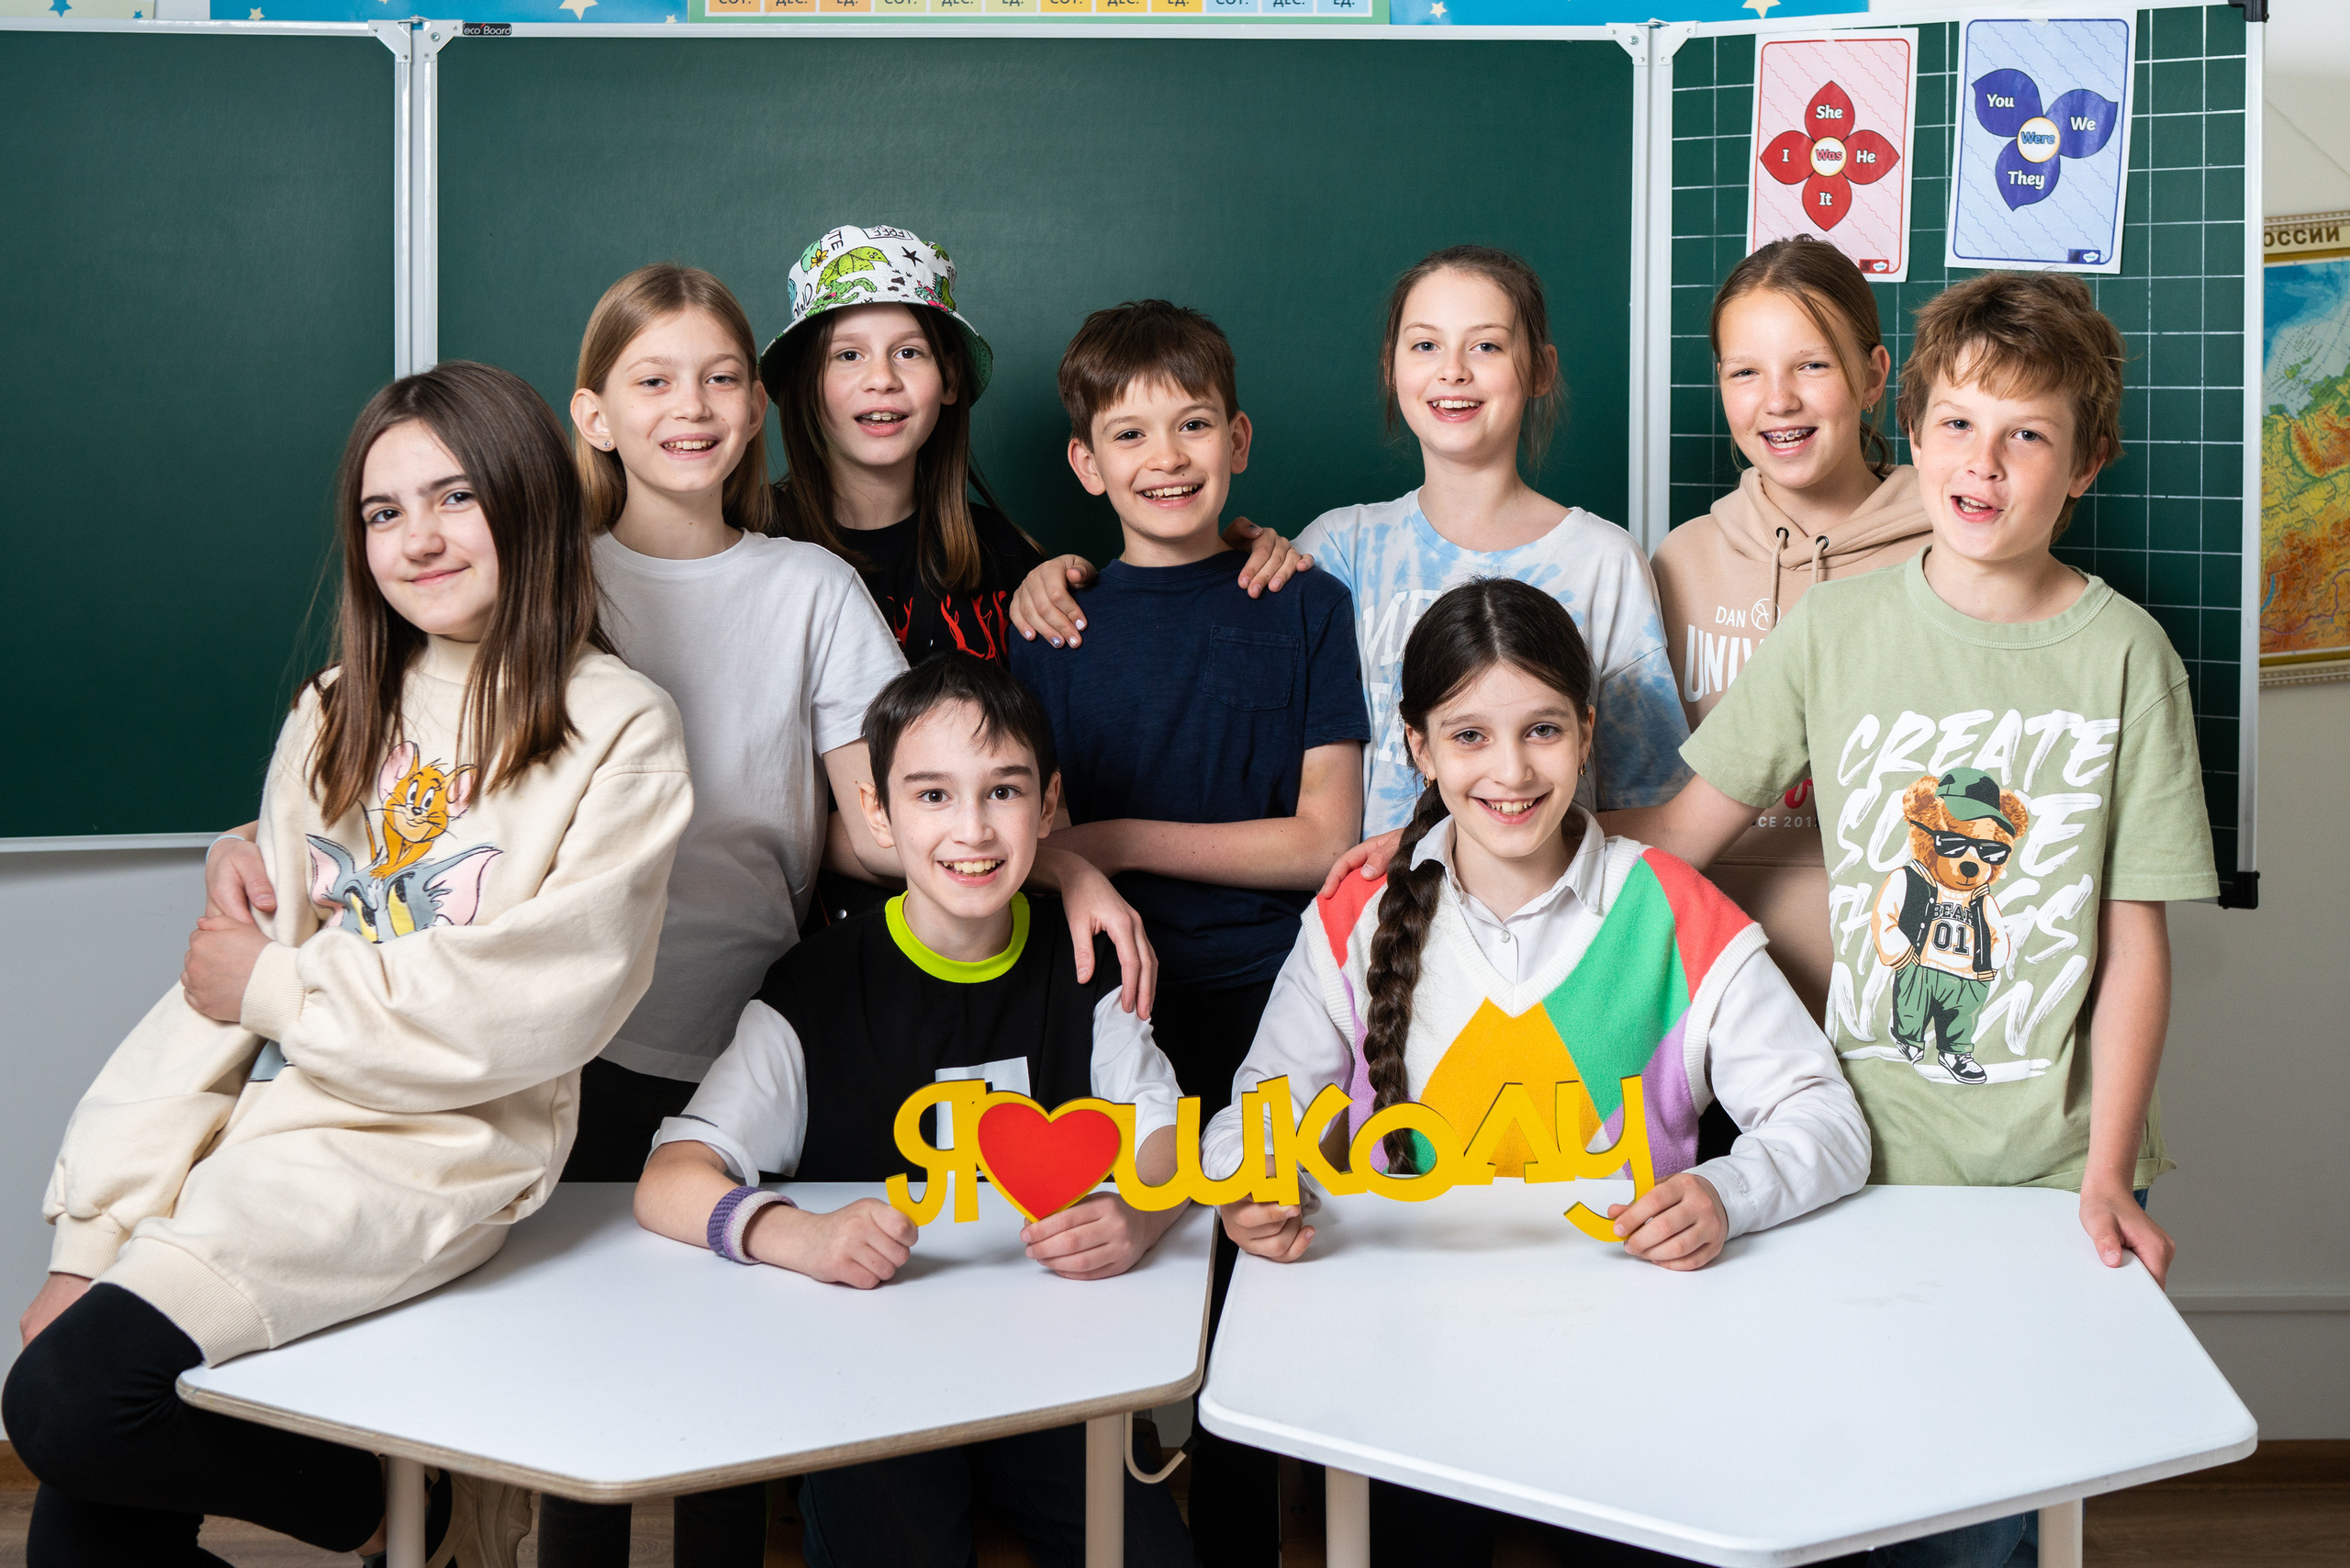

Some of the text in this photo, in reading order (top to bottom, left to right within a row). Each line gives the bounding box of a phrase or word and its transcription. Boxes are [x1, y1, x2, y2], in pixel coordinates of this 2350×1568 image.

[483, 25, 512, 35] Board
[1986, 94, 2015, 108] You
[1816, 104, 1843, 119] She
[2070, 117, 2096, 131] We
[2020, 131, 2055, 144] Were
[1782, 149, 1790, 162] I
[1816, 149, 1843, 162] Was
[1856, 150, 1876, 164] He
[2007, 169, 2045, 190] They
[1818, 192, 1833, 206] It
[1715, 605, 1747, 628] DAN
[1837, 710, 2121, 791] CREATE
[1751, 815, 1818, 828] CE 201
[1830, 789, 2103, 879] SOE
[1932, 902, 1974, 926] BEAR
[1931, 920, 1969, 955] 01
[1825, 955, 2088, 1057] NW
[886, 1077, 987, 1227] Я
